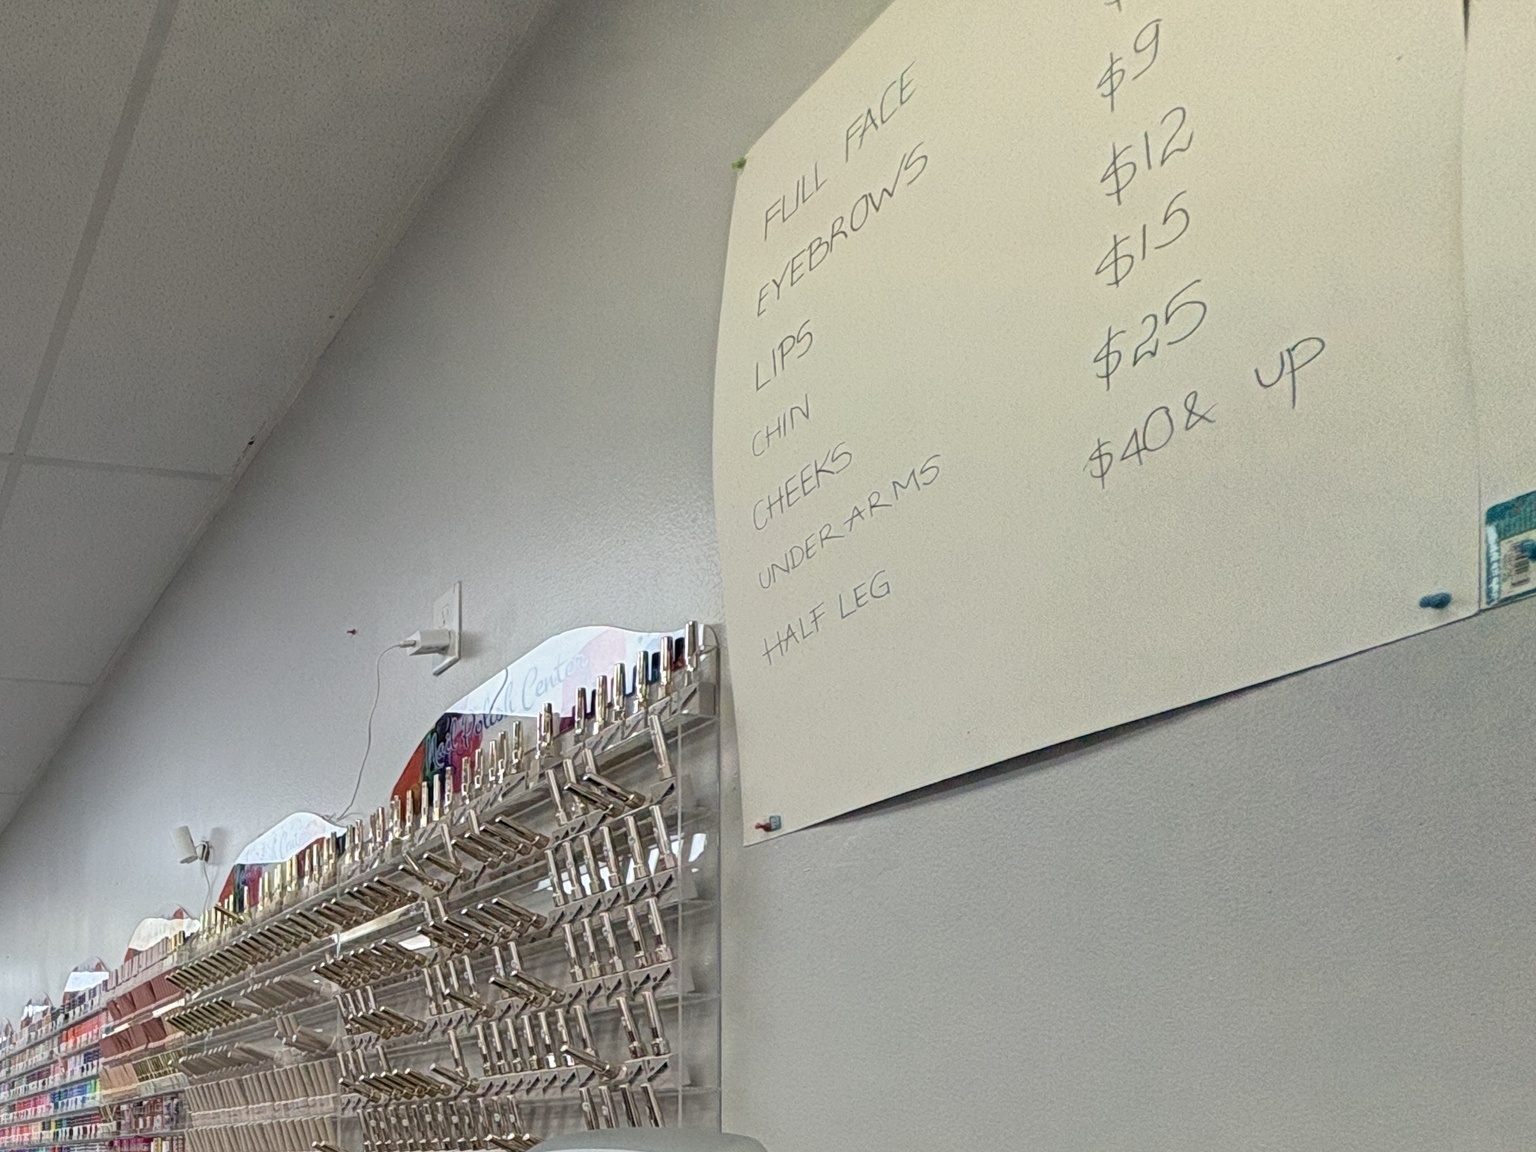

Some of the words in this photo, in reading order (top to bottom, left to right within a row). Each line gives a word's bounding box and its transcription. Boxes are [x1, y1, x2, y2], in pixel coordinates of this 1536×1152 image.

[1096, 18, 1163, 112] $9
[764, 162, 828, 242] FULL
[845, 61, 917, 164] FACE
[1099, 106, 1195, 206] $12
[756, 141, 929, 318] EYEBROWS
[1094, 190, 1190, 288] $15
[755, 319, 814, 392] LIPS
[1092, 279, 1208, 392] $25
[751, 393, 810, 457] CHIN
[752, 441, 853, 531] CHEEKS
[762, 601, 826, 666] HALF
[838, 569, 891, 620] LEG
[521, 656, 588, 713] Center
